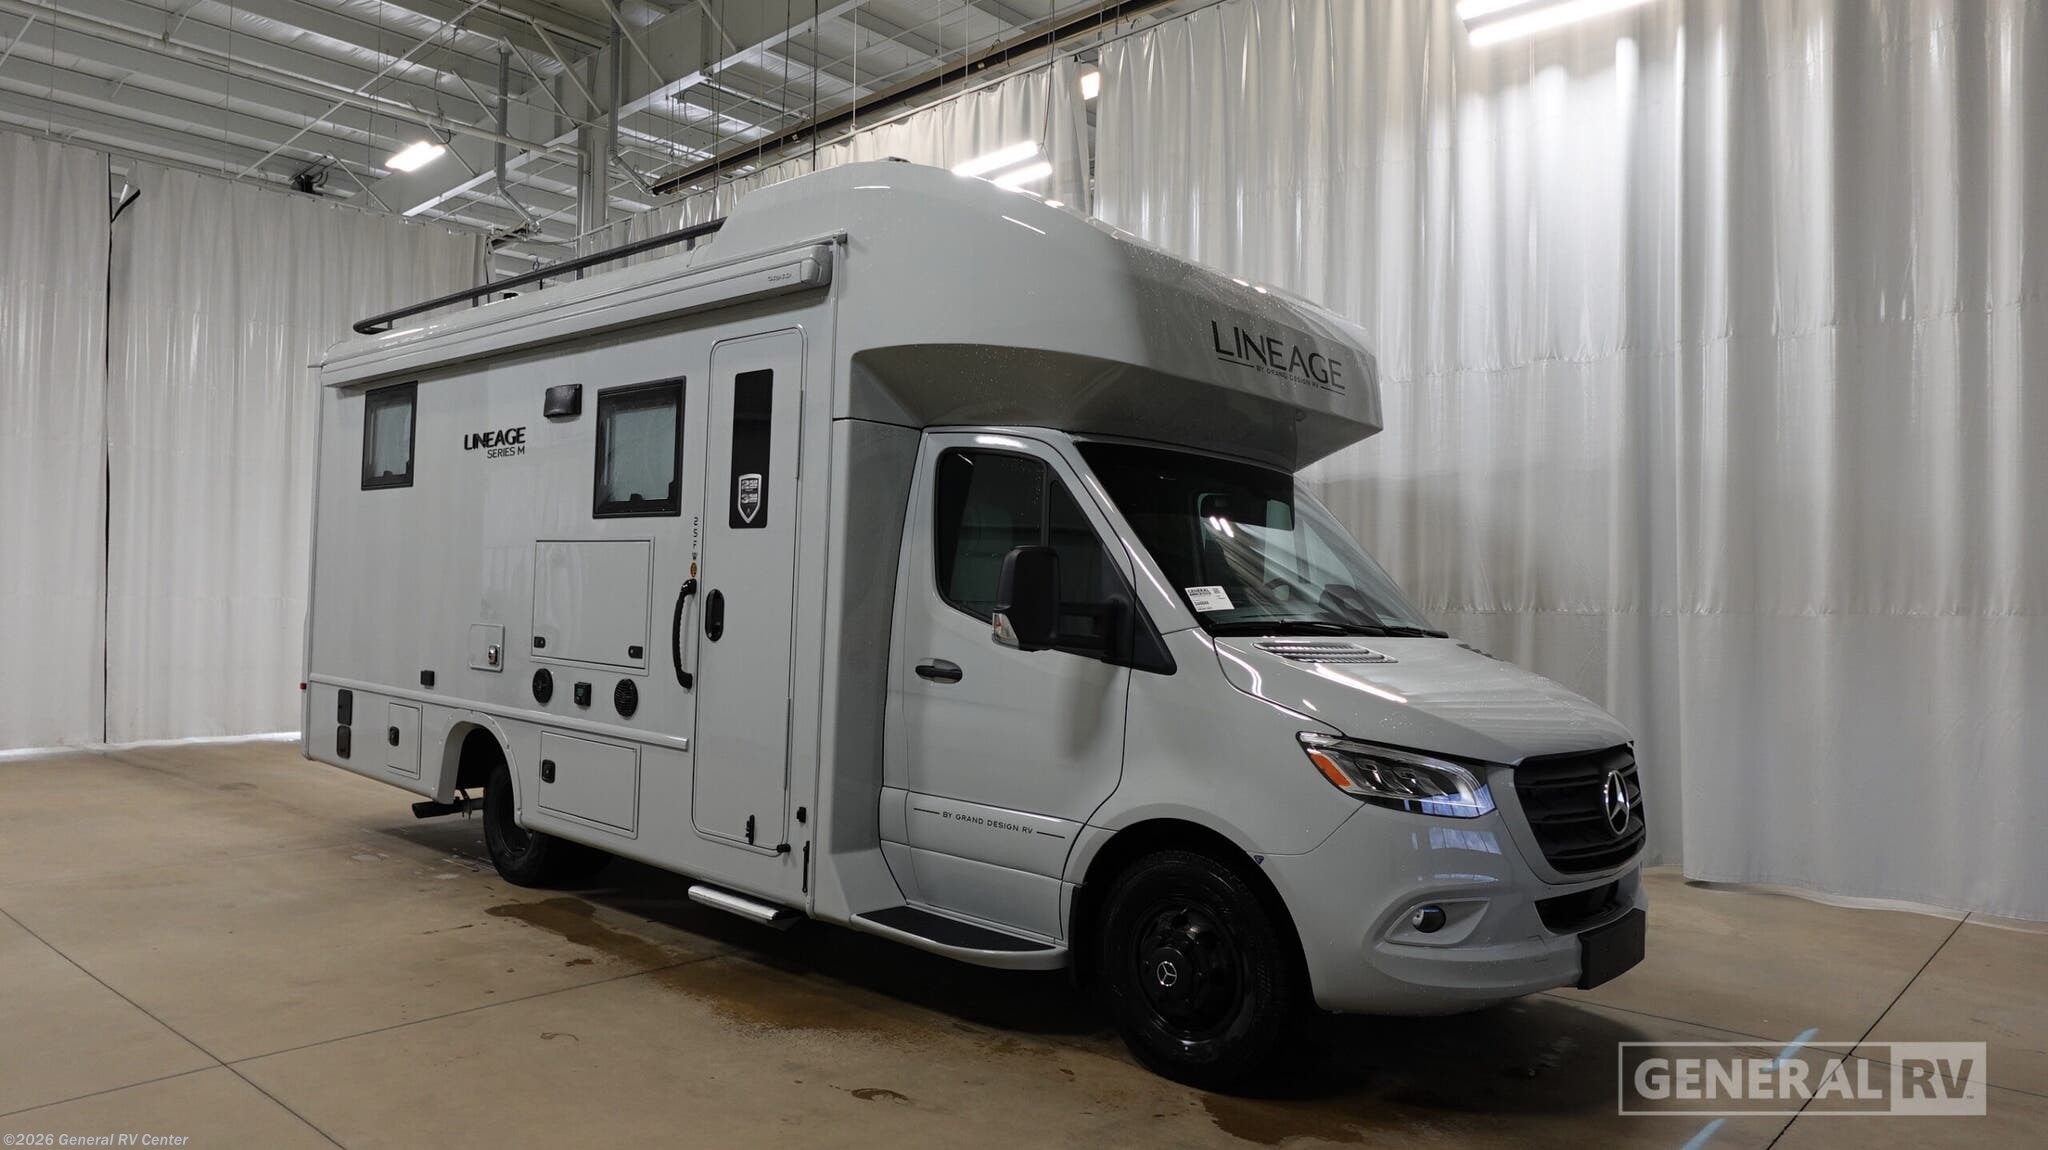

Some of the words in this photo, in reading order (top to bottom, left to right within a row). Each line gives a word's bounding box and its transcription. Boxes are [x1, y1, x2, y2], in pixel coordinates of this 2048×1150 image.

[1211, 320, 1345, 390] LINEAGE
[464, 426, 527, 450] LINEAGE
[487, 446, 516, 459] SERIES
[517, 445, 526, 456] M
[942, 811, 952, 819] BY
[955, 813, 984, 825] GRAND
[986, 819, 1019, 832] DESIGN
[1021, 826, 1033, 835] RV
